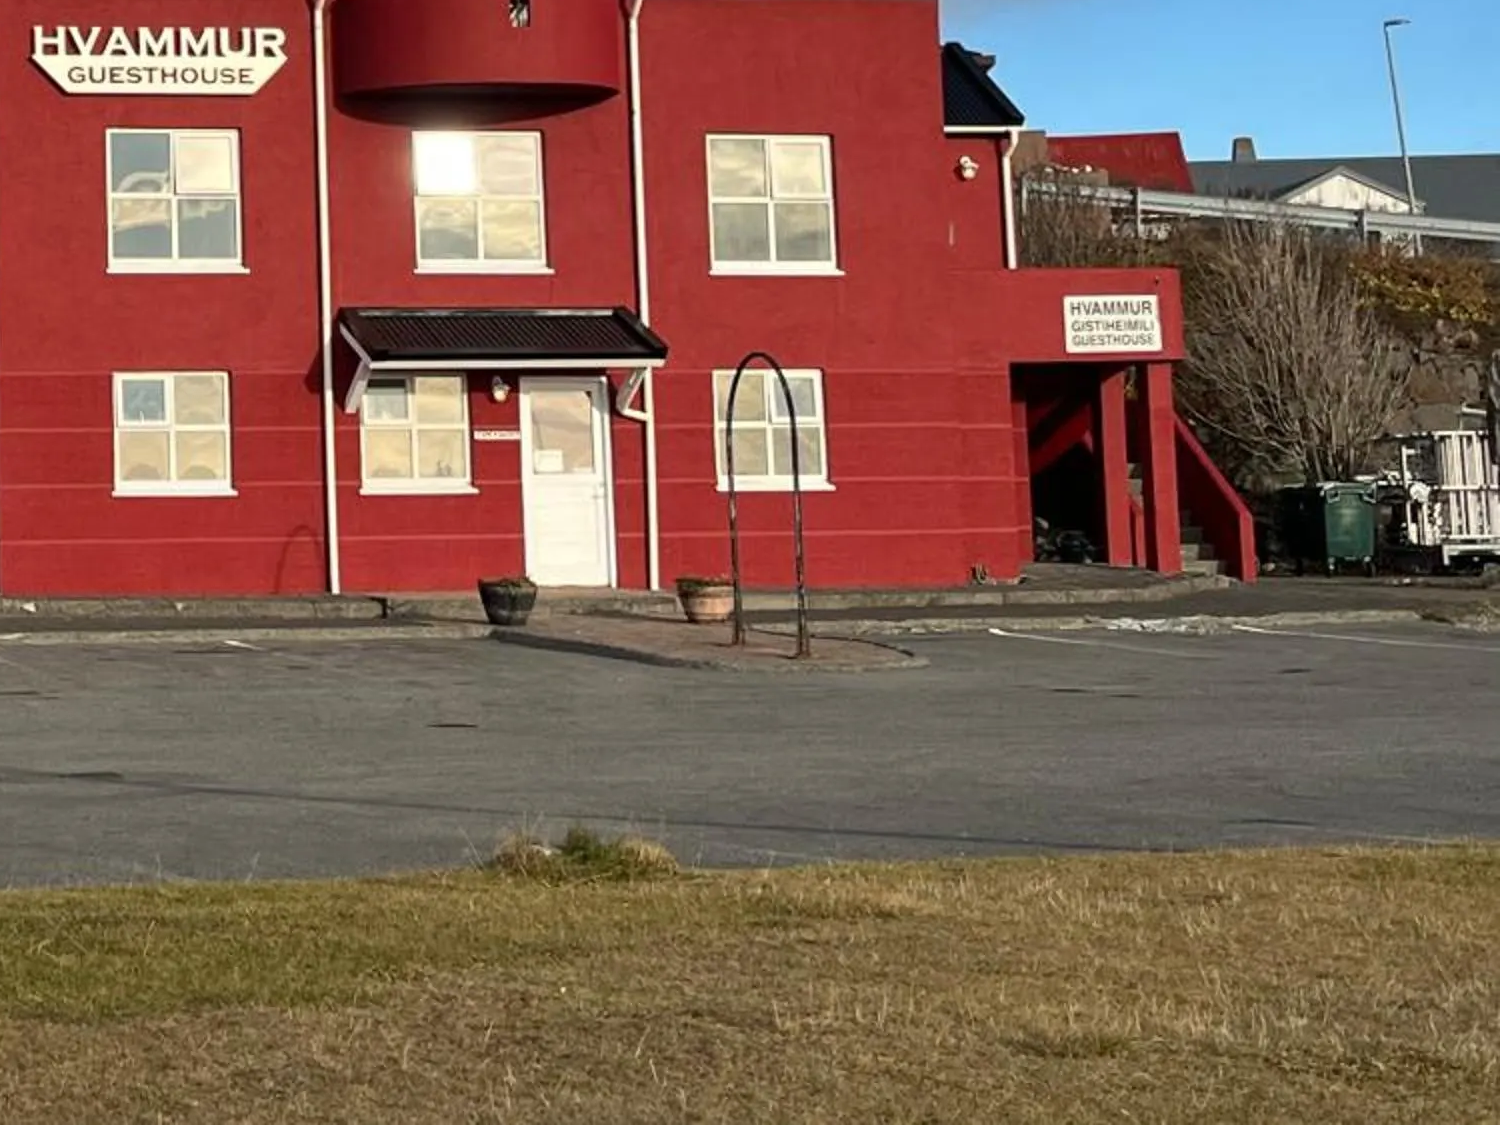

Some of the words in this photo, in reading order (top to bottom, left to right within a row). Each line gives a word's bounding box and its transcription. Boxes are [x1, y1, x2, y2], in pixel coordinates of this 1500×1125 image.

[33, 26, 286, 56] HVAMMUR
[67, 66, 254, 84] GUESTHOUSE
[1070, 300, 1153, 315] HVAMMUR
[1071, 319, 1154, 332] GISTIHEIMILI
[1072, 334, 1154, 346] GUESTHOUSE
